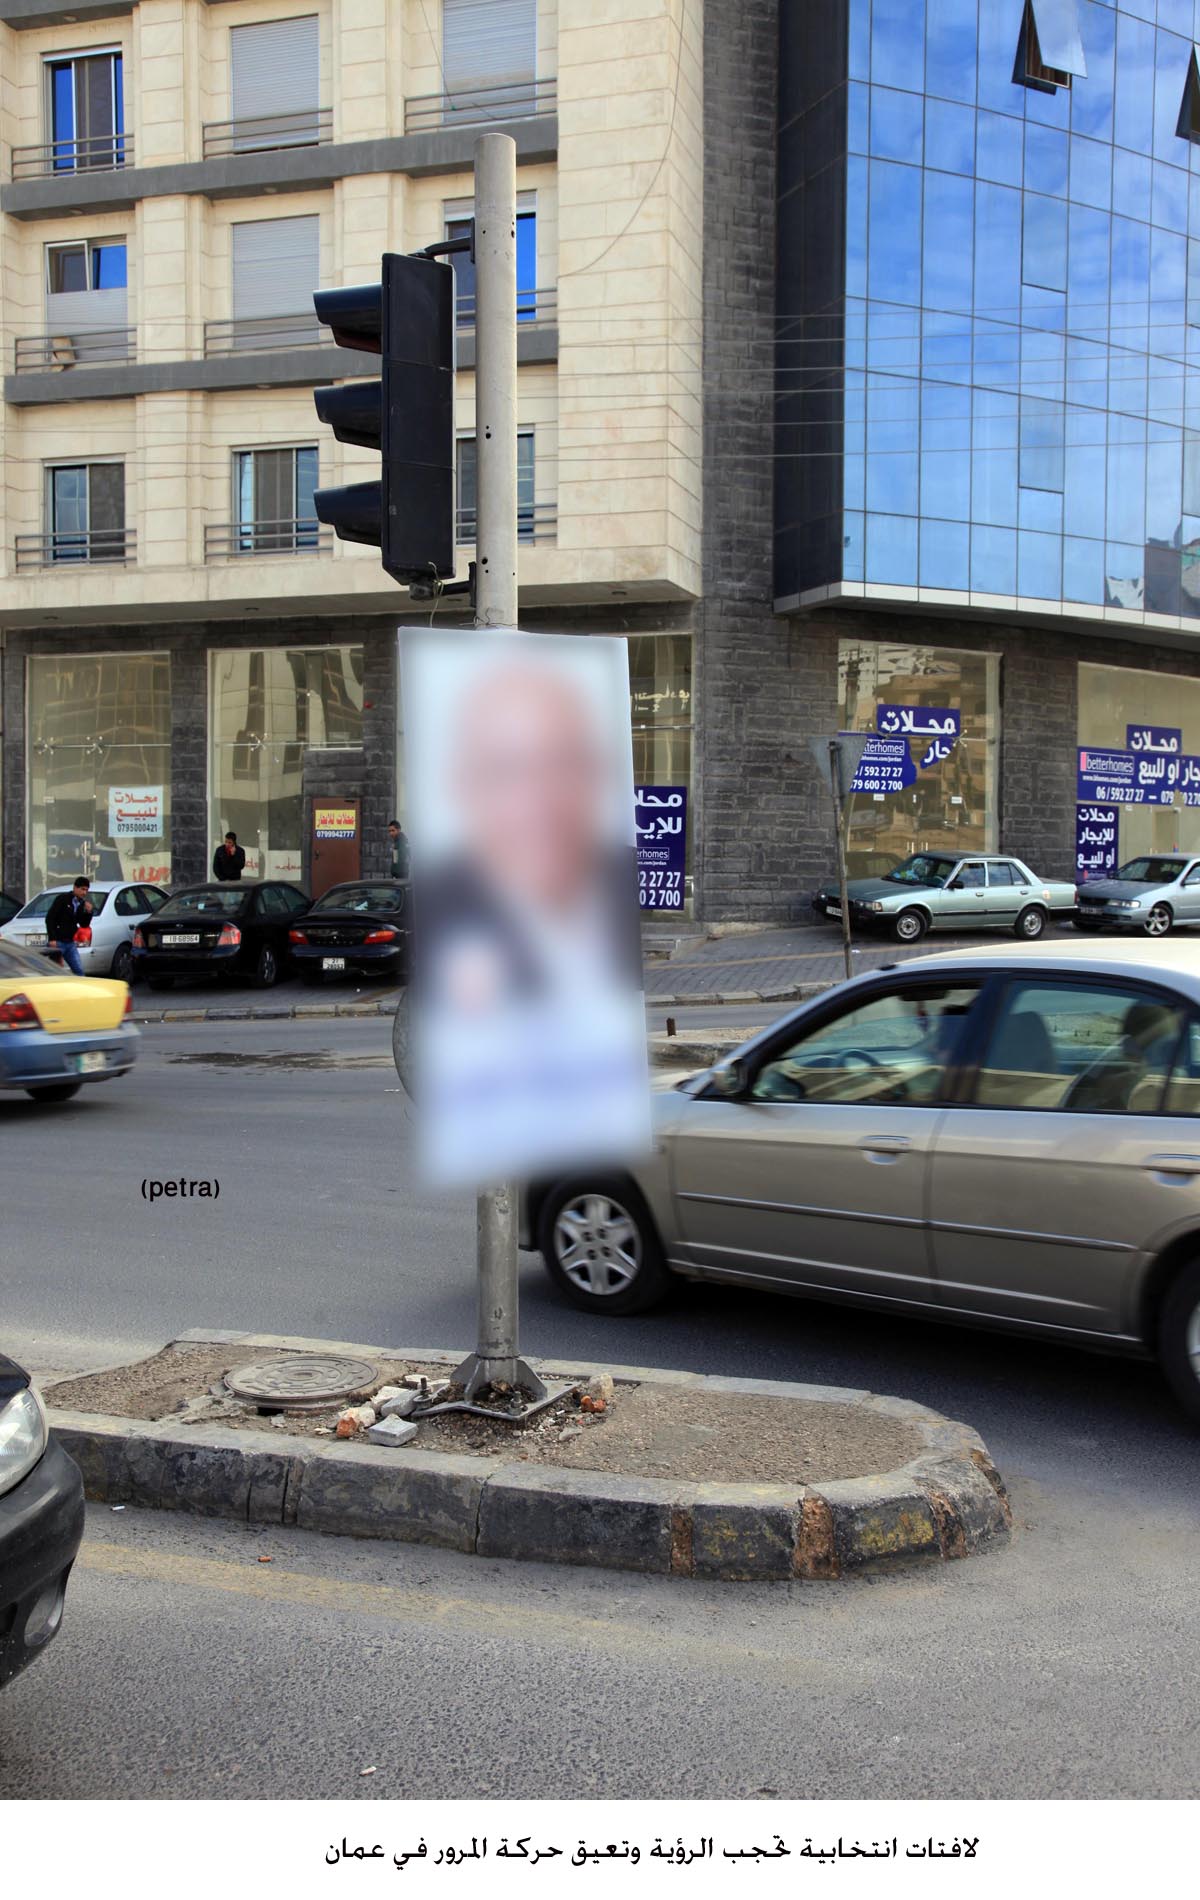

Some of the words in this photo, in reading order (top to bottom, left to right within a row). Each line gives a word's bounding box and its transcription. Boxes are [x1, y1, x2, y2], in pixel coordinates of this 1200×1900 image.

[881, 710, 956, 735] محلات
[865, 742, 903, 754] terhomes
[1131, 731, 1178, 752] محلات
[864, 766, 880, 776] 592
[880, 766, 891, 777] 27
[892, 767, 903, 778] 27
[1087, 756, 1133, 773] betterhomes
[1138, 757, 1165, 784] للبيع
[851, 779, 863, 790] 79
[864, 779, 880, 790] 600
[880, 780, 887, 791] 2
[887, 780, 903, 791] 700
[115, 791, 158, 804] محلات
[1125, 788, 1135, 802] 27
[1135, 789, 1145, 803] 27
[116, 806, 158, 822] للبيع
[1078, 807, 1115, 823] محلات
[1077, 850, 1104, 869] للبيع
[649, 870, 664, 888] 27
[666, 870, 681, 888] 27
[648, 889, 656, 906] 2
[658, 889, 681, 906] 700
